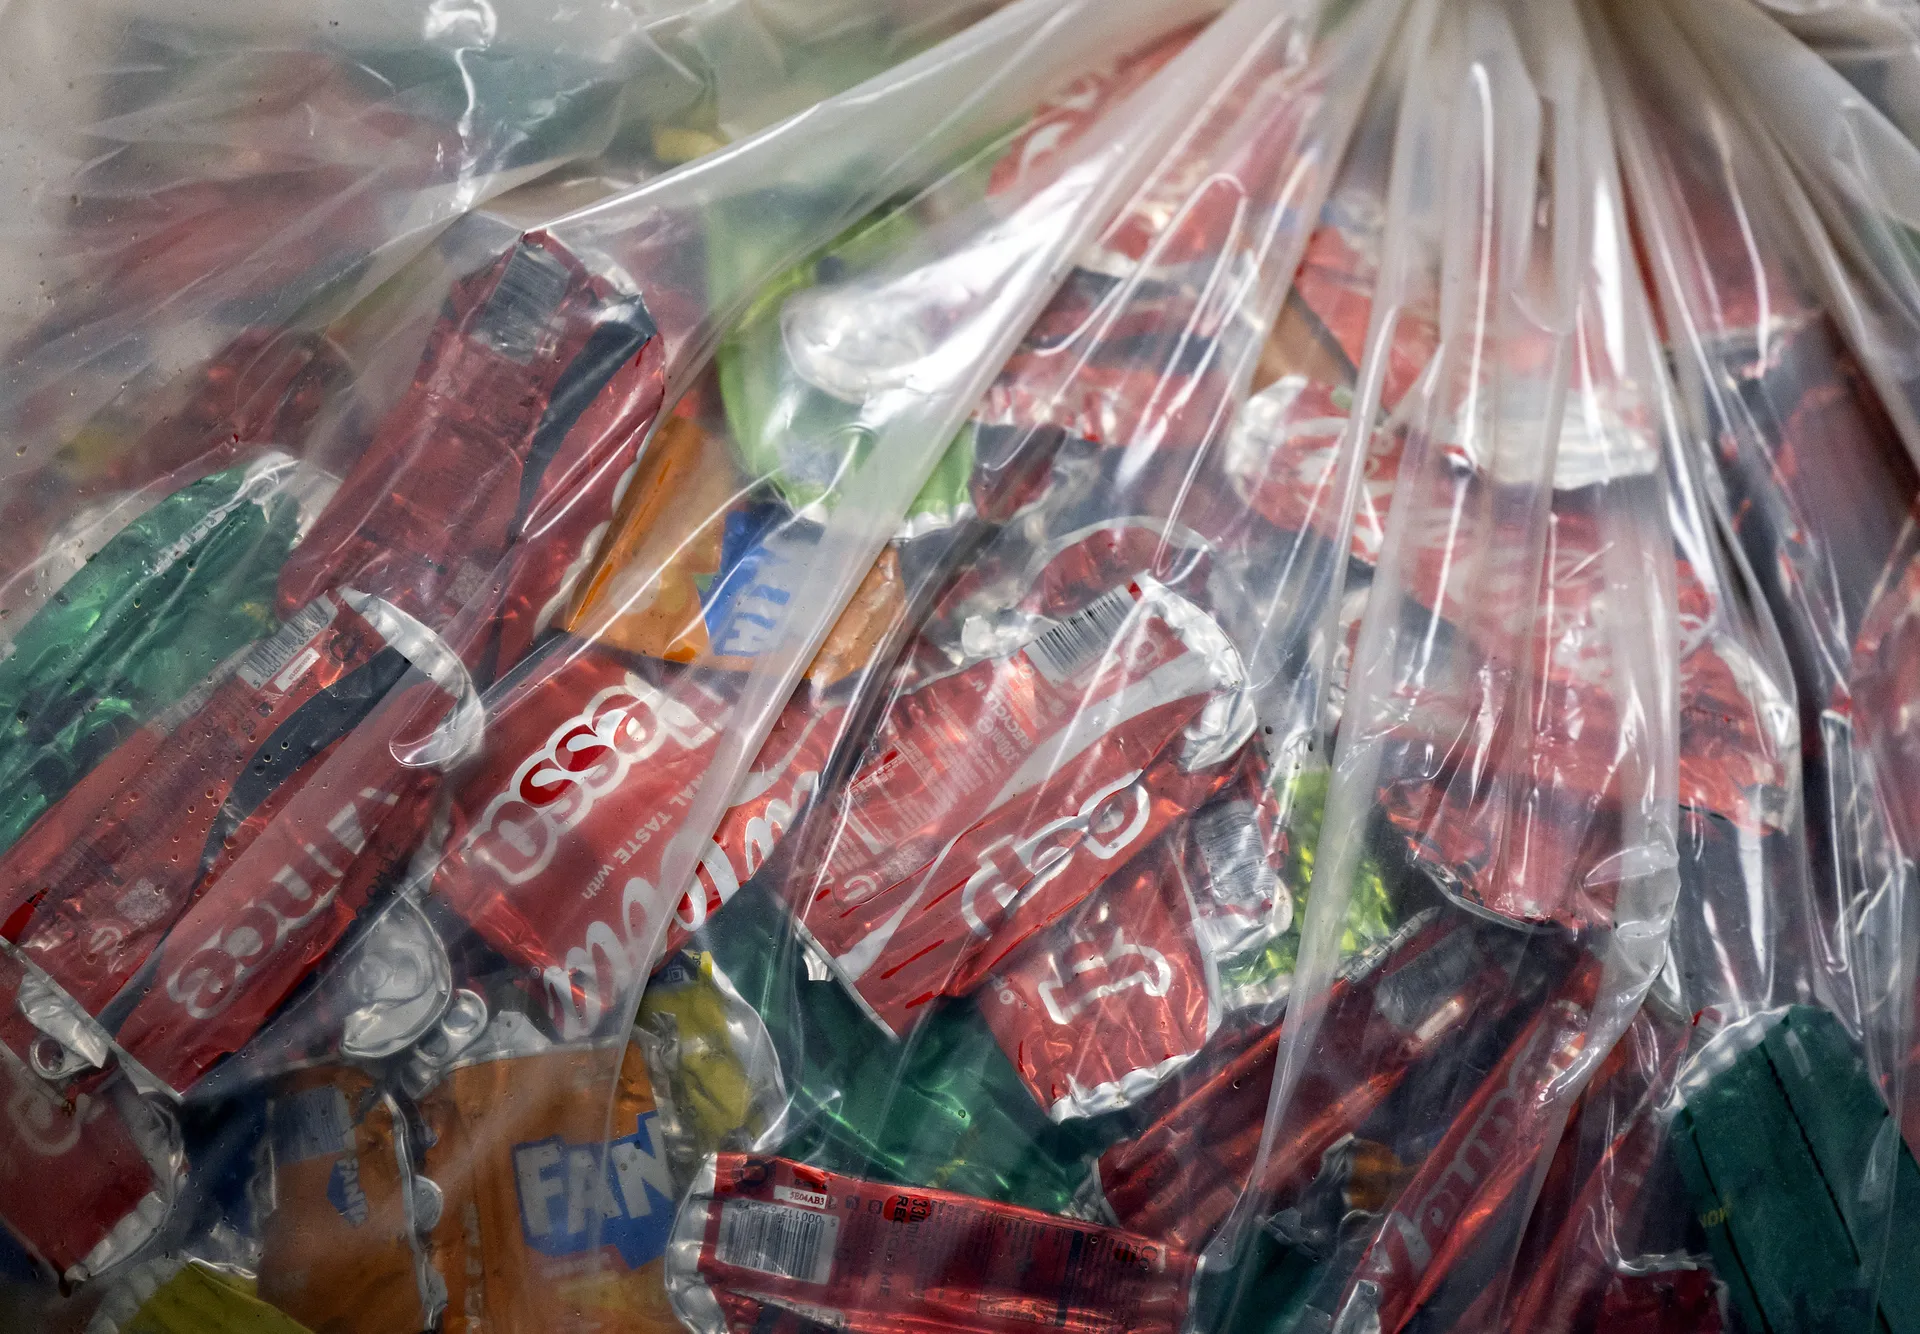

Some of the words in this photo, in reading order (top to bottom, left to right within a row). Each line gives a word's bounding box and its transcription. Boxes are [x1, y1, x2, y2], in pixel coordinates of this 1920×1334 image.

[613, 811, 673, 864] TASTE
[581, 864, 615, 899] with
[518, 1115, 674, 1236] FAN
